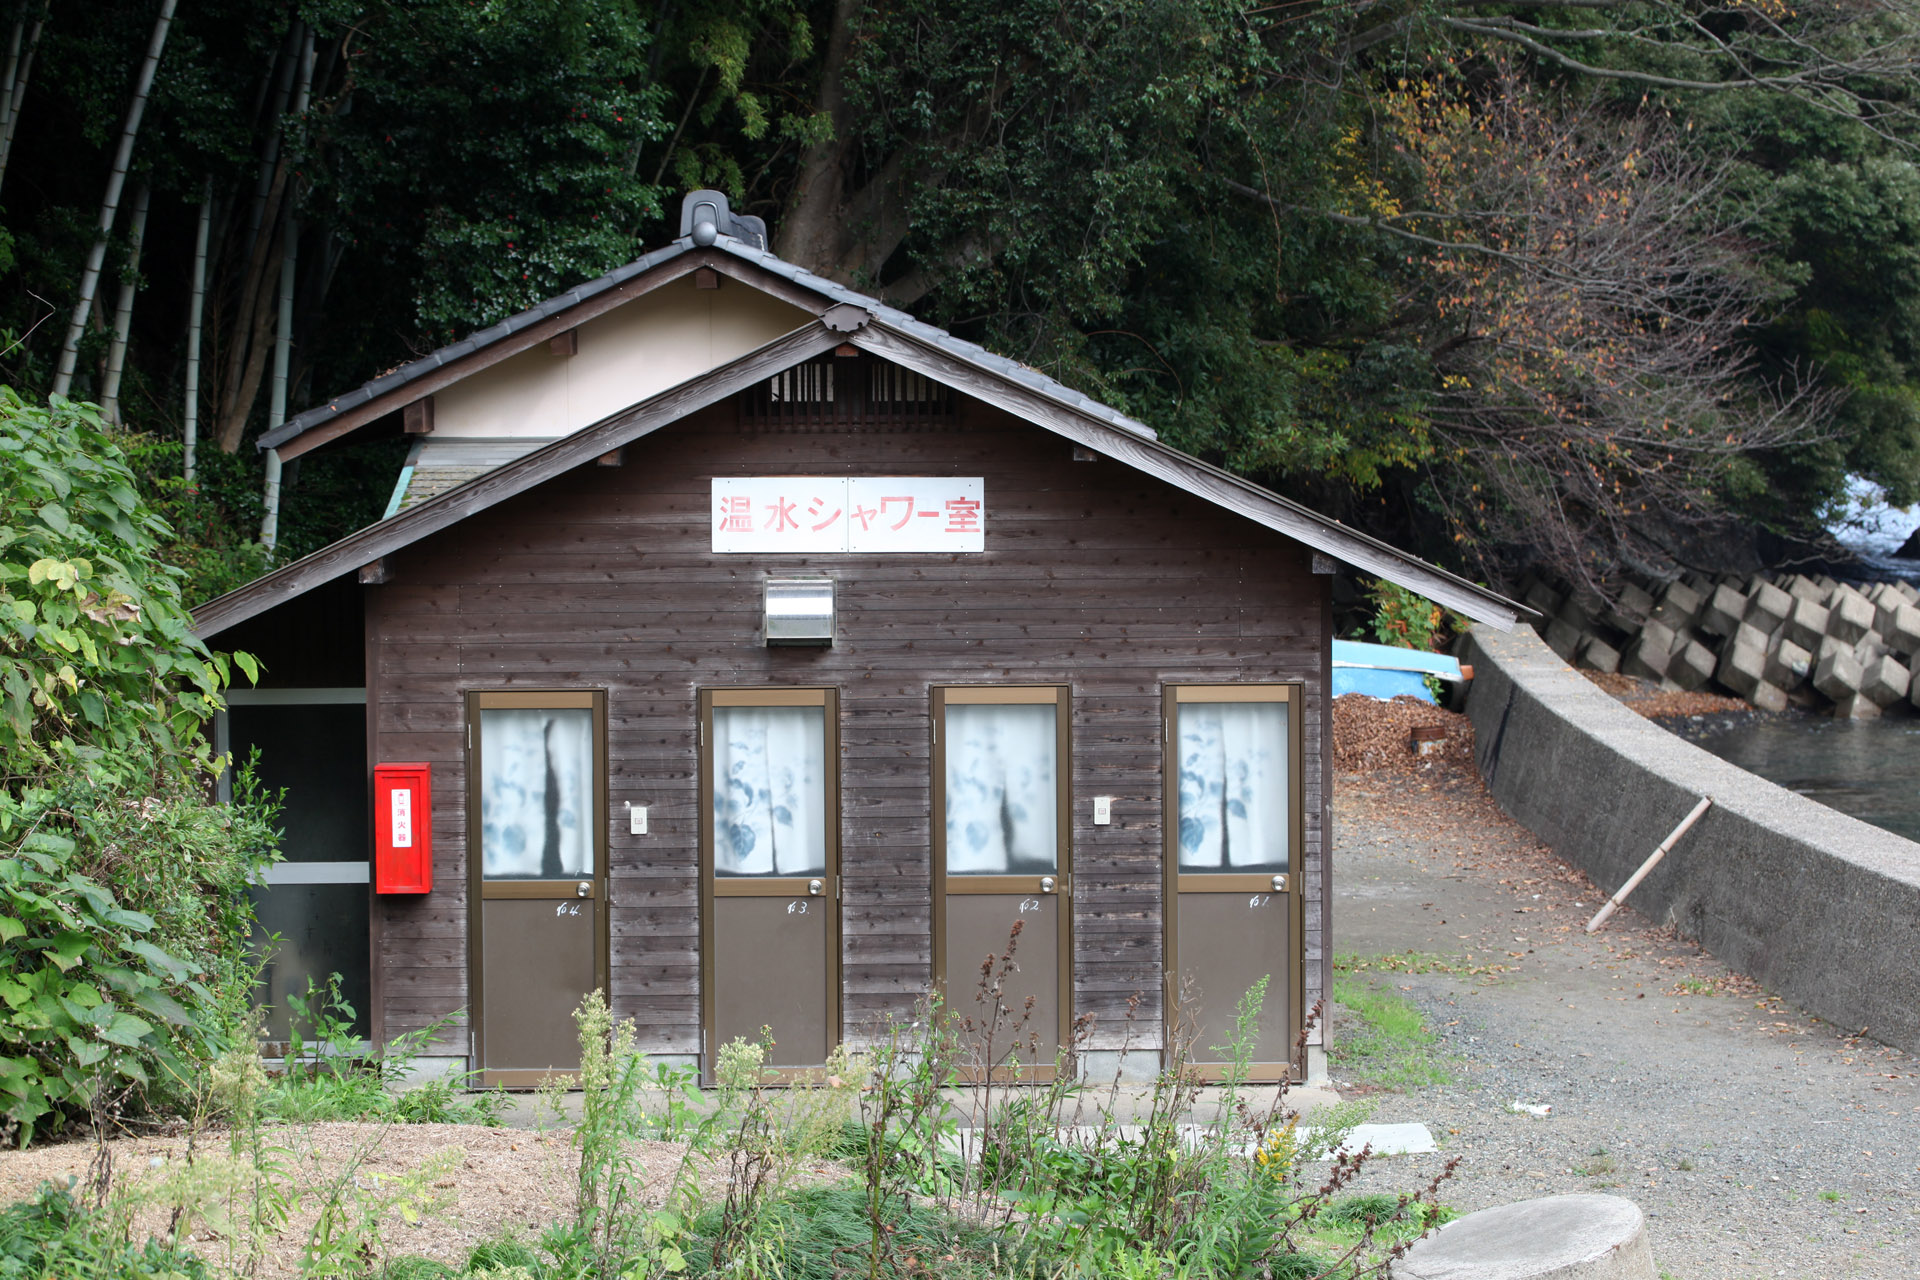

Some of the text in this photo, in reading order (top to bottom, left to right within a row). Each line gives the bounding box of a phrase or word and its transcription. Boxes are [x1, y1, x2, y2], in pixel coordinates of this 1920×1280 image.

[719, 496, 981, 533] 温水シャワー室
[397, 808, 406, 841] 消火器
